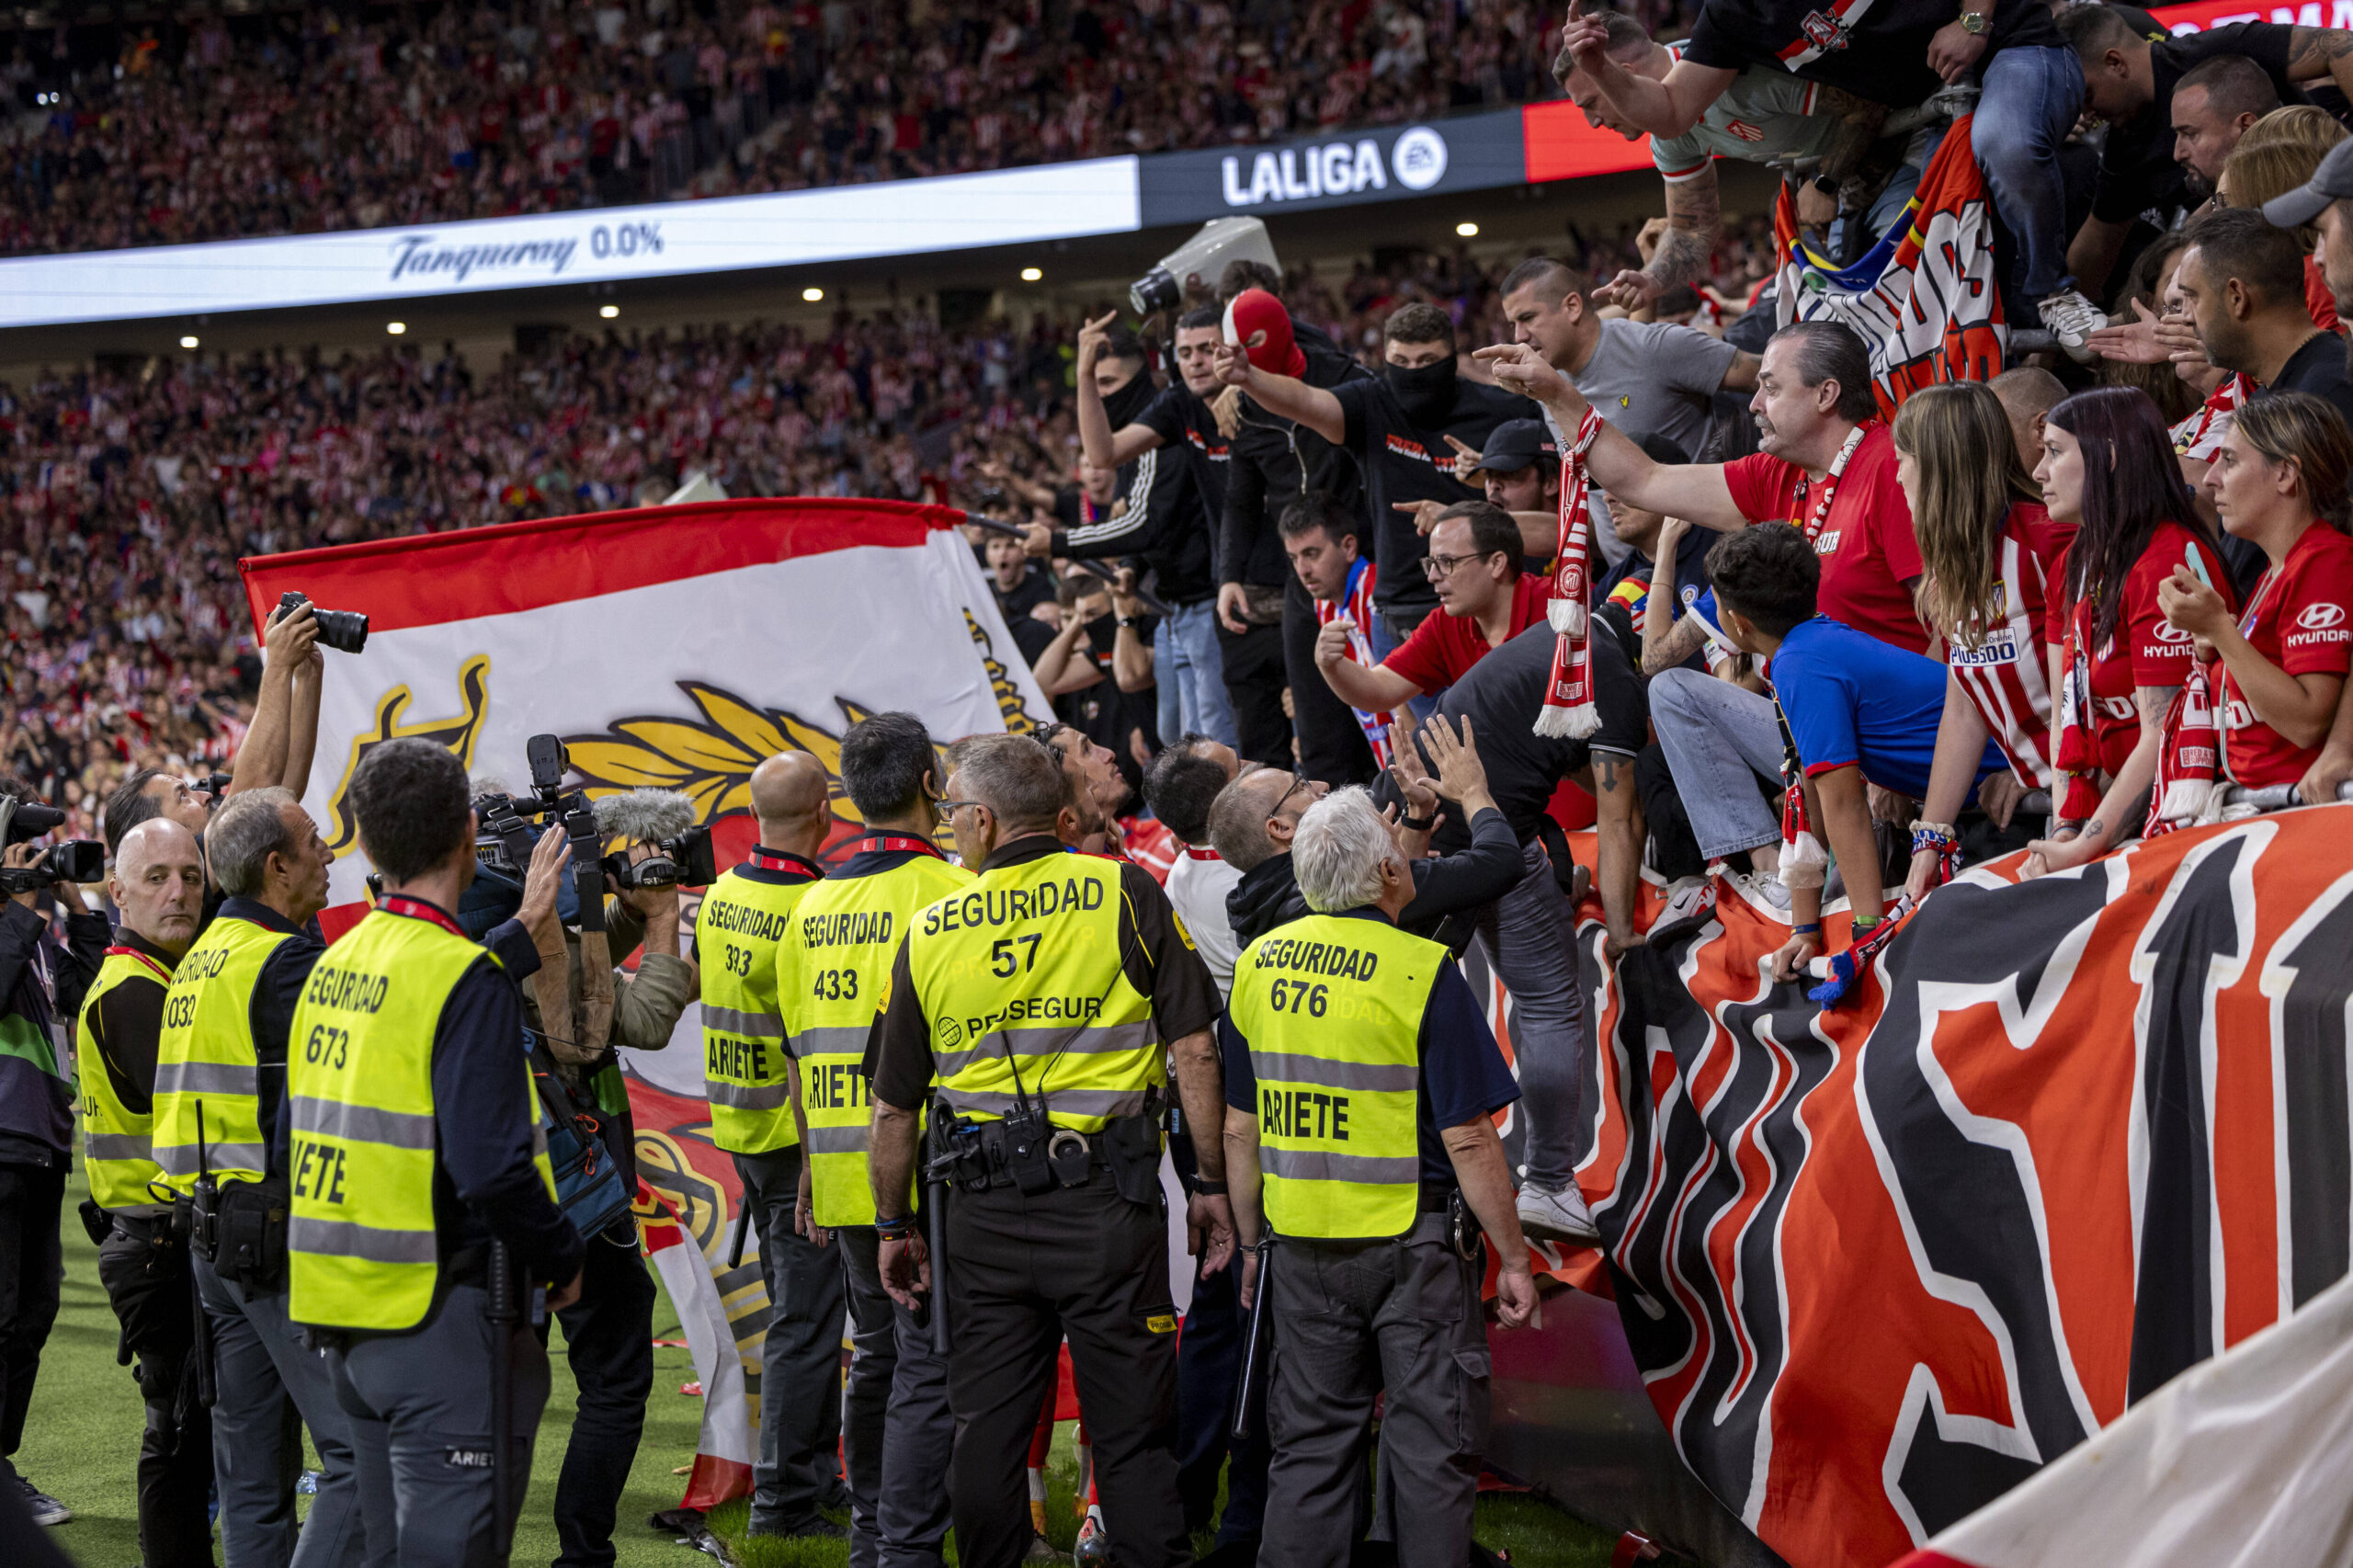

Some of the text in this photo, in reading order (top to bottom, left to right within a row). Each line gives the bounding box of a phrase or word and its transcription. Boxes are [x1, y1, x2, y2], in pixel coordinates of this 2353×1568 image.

[1222, 139, 1388, 207] LALIGA
[389, 221, 665, 281] Tanqueray 0.0%
[1950, 642, 2016, 664] Plus500
[2143, 644, 2194, 657] HYUND
[708, 900, 787, 942] SEGURIDAD
[924, 877, 1104, 936] SEGURIDAD
[803, 911, 893, 949] SEGURIDAD
[992, 932, 1042, 979] 57
[1256, 939, 1378, 982] SEGURIDAD
[308, 965, 389, 1014] EGURIDAD
[813, 969, 858, 1001] 433
[1271, 978, 1329, 1017] 676
[162, 994, 196, 1030] 1032
[306, 1024, 349, 1071] 673
[709, 1037, 769, 1080] ARIETE
[1263, 1089, 1349, 1141] ARIETE
[291, 1138, 347, 1205] IETE
[449, 1450, 495, 1467] ARIET
